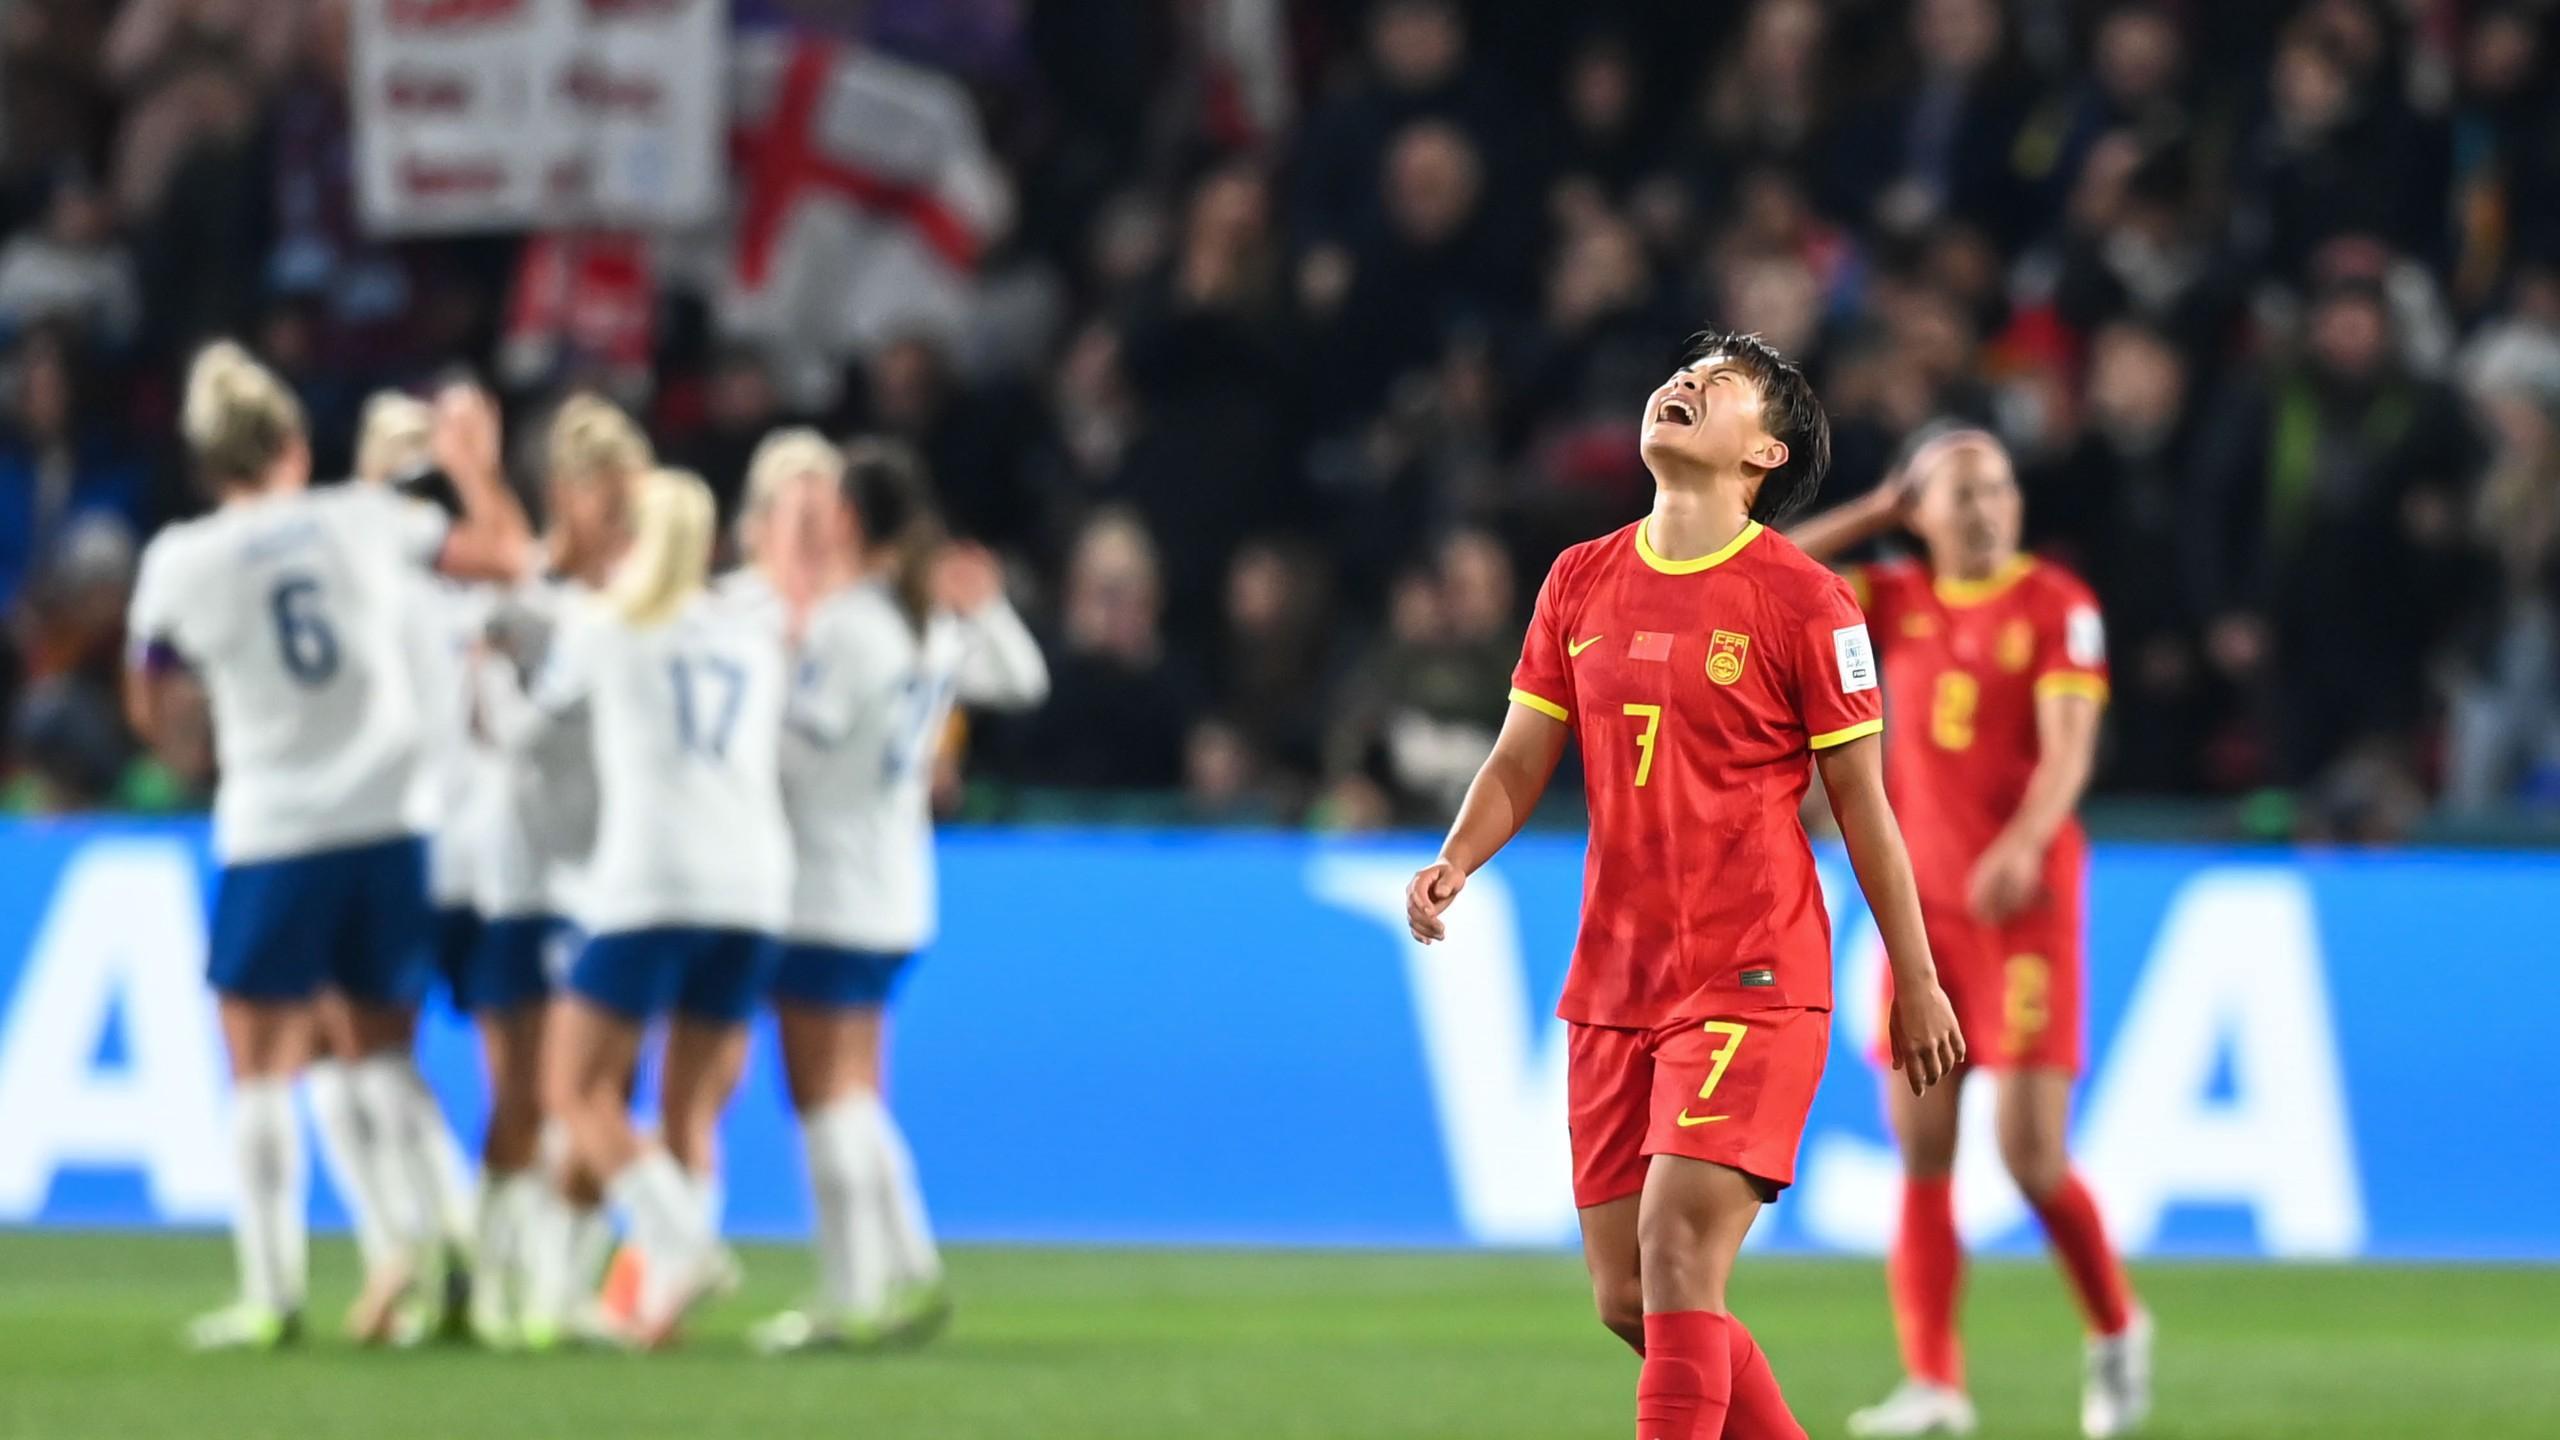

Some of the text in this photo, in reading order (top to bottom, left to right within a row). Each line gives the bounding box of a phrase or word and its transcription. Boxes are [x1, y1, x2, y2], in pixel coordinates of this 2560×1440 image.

[271, 572, 340, 685] 6
[669, 654, 749, 762] 17
[1623, 703, 1661, 787] 7
[1698, 1021, 1748, 1099] 7
